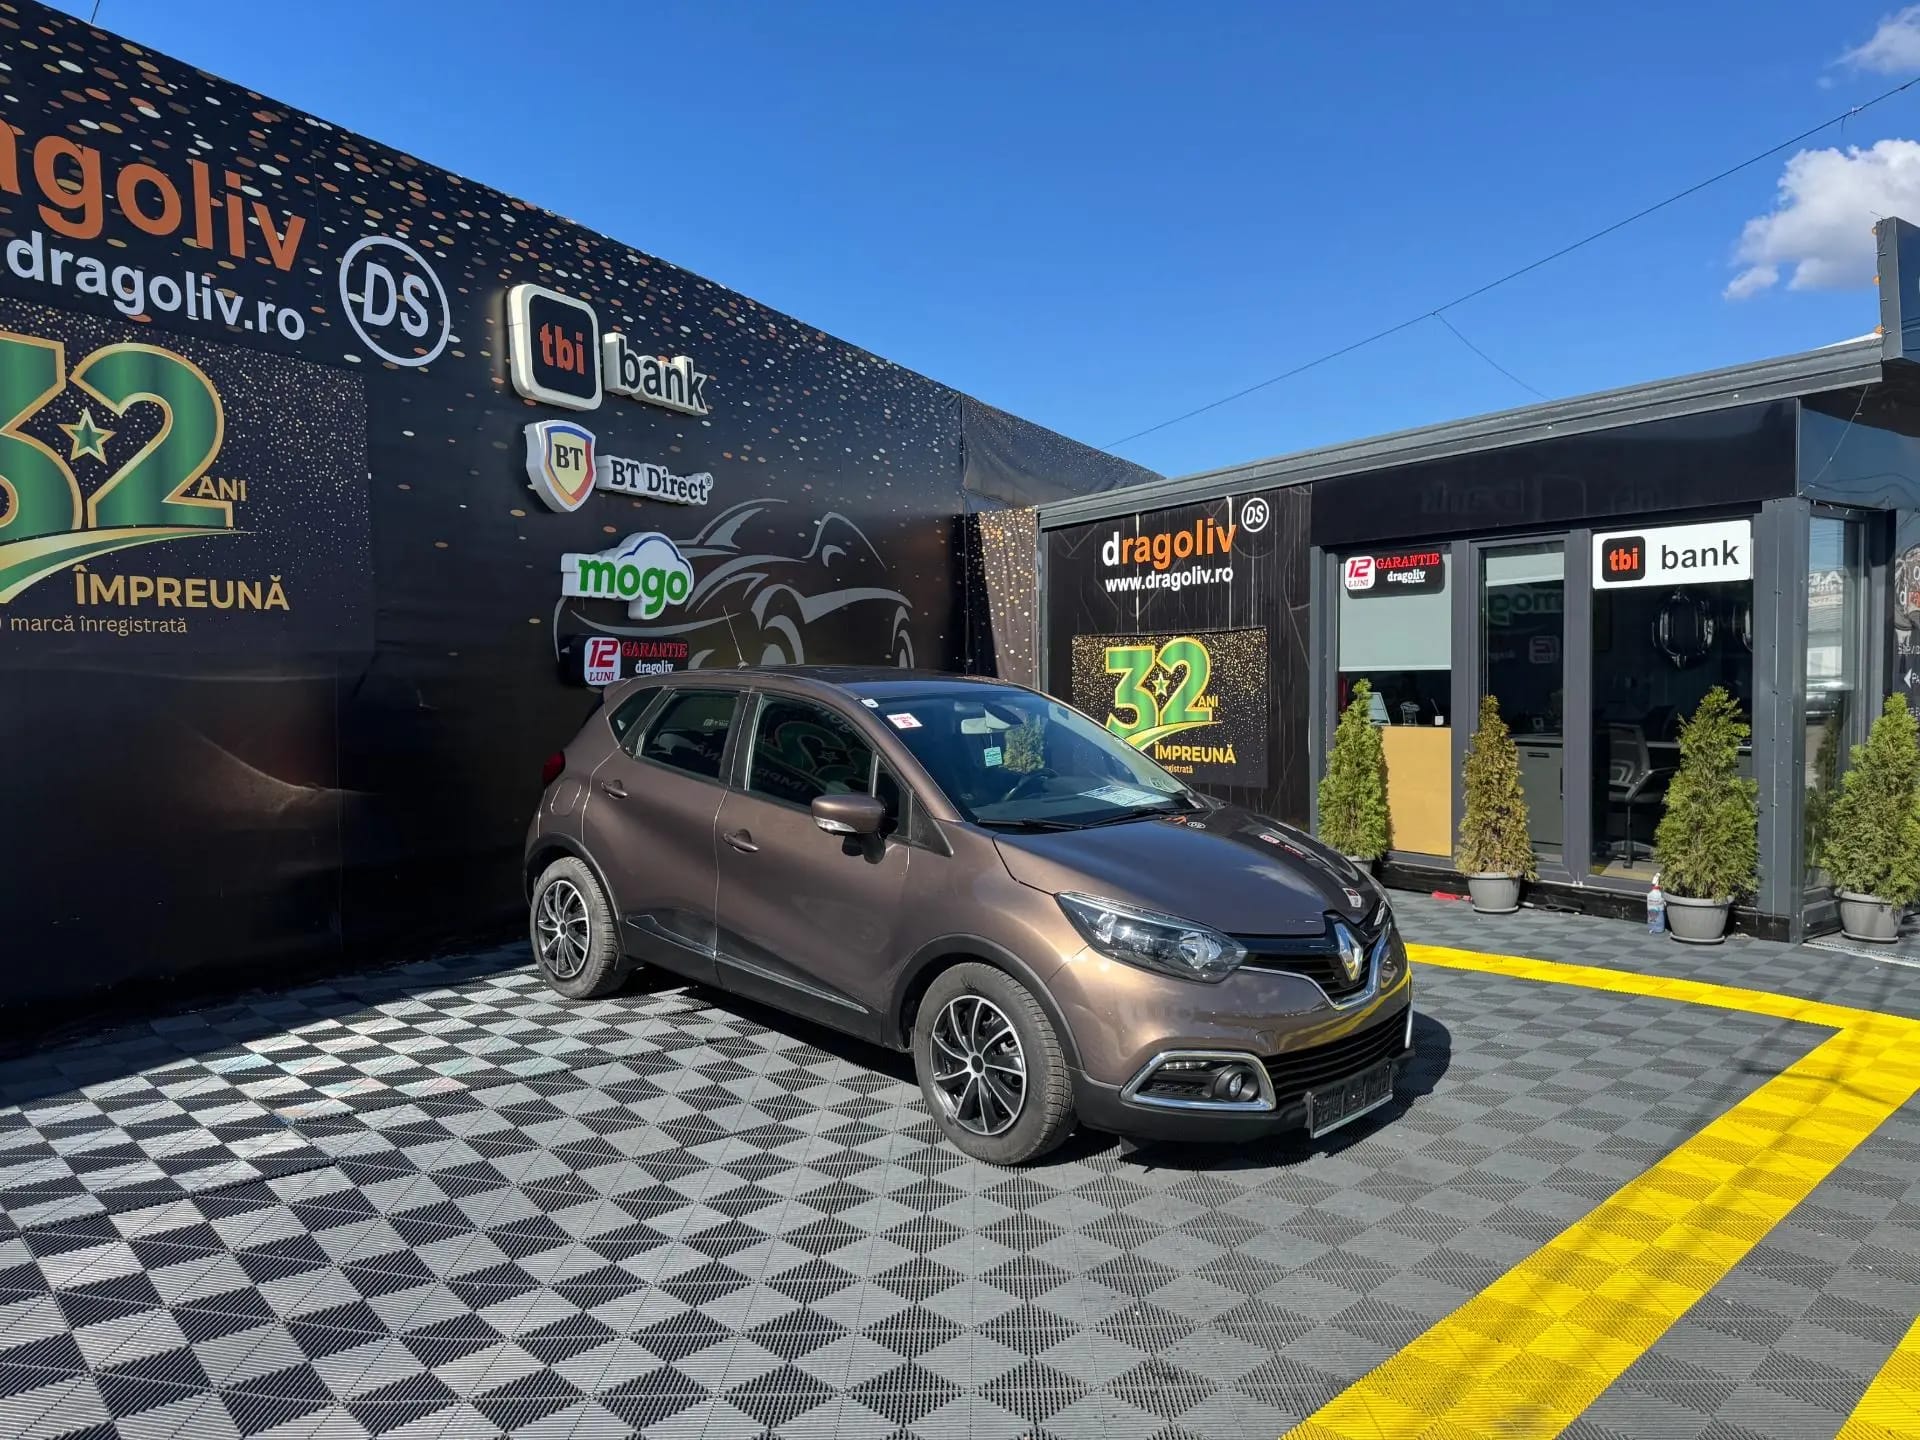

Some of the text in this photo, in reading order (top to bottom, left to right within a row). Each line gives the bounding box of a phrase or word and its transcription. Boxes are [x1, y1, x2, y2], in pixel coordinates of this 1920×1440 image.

[6, 230, 305, 341] dragoliv.ro
[363, 261, 429, 338] DS
[539, 321, 707, 410] tbi bank
[554, 443, 583, 471] BT
[610, 459, 639, 488] BT
[197, 475, 247, 501] ANI
[1246, 506, 1265, 525] DS
[1102, 518, 1237, 570] dragoliv
[1609, 539, 1739, 572] tbi bank
[1348, 559, 1372, 578] 12
[1376, 552, 1440, 569] GARANTIE
[72, 564, 291, 611] ÎMPREUNĂ
[578, 558, 688, 615] mogo
[1105, 566, 1234, 592] www.dragoliv.ro
[1348, 579, 1369, 588] LUNI
[1386, 568, 1426, 583] dragoliv
[10, 614, 188, 637] marcă înregistrată
[588, 639, 619, 668] 12
[621, 641, 689, 659] GARANTIE
[588, 671, 615, 682] LUNI
[634, 659, 674, 674] dragoliv
[1104, 636, 1212, 738] 32
[1197, 695, 1220, 708] ANI
[1154, 740, 1237, 764] ÎMPREUNĂ
